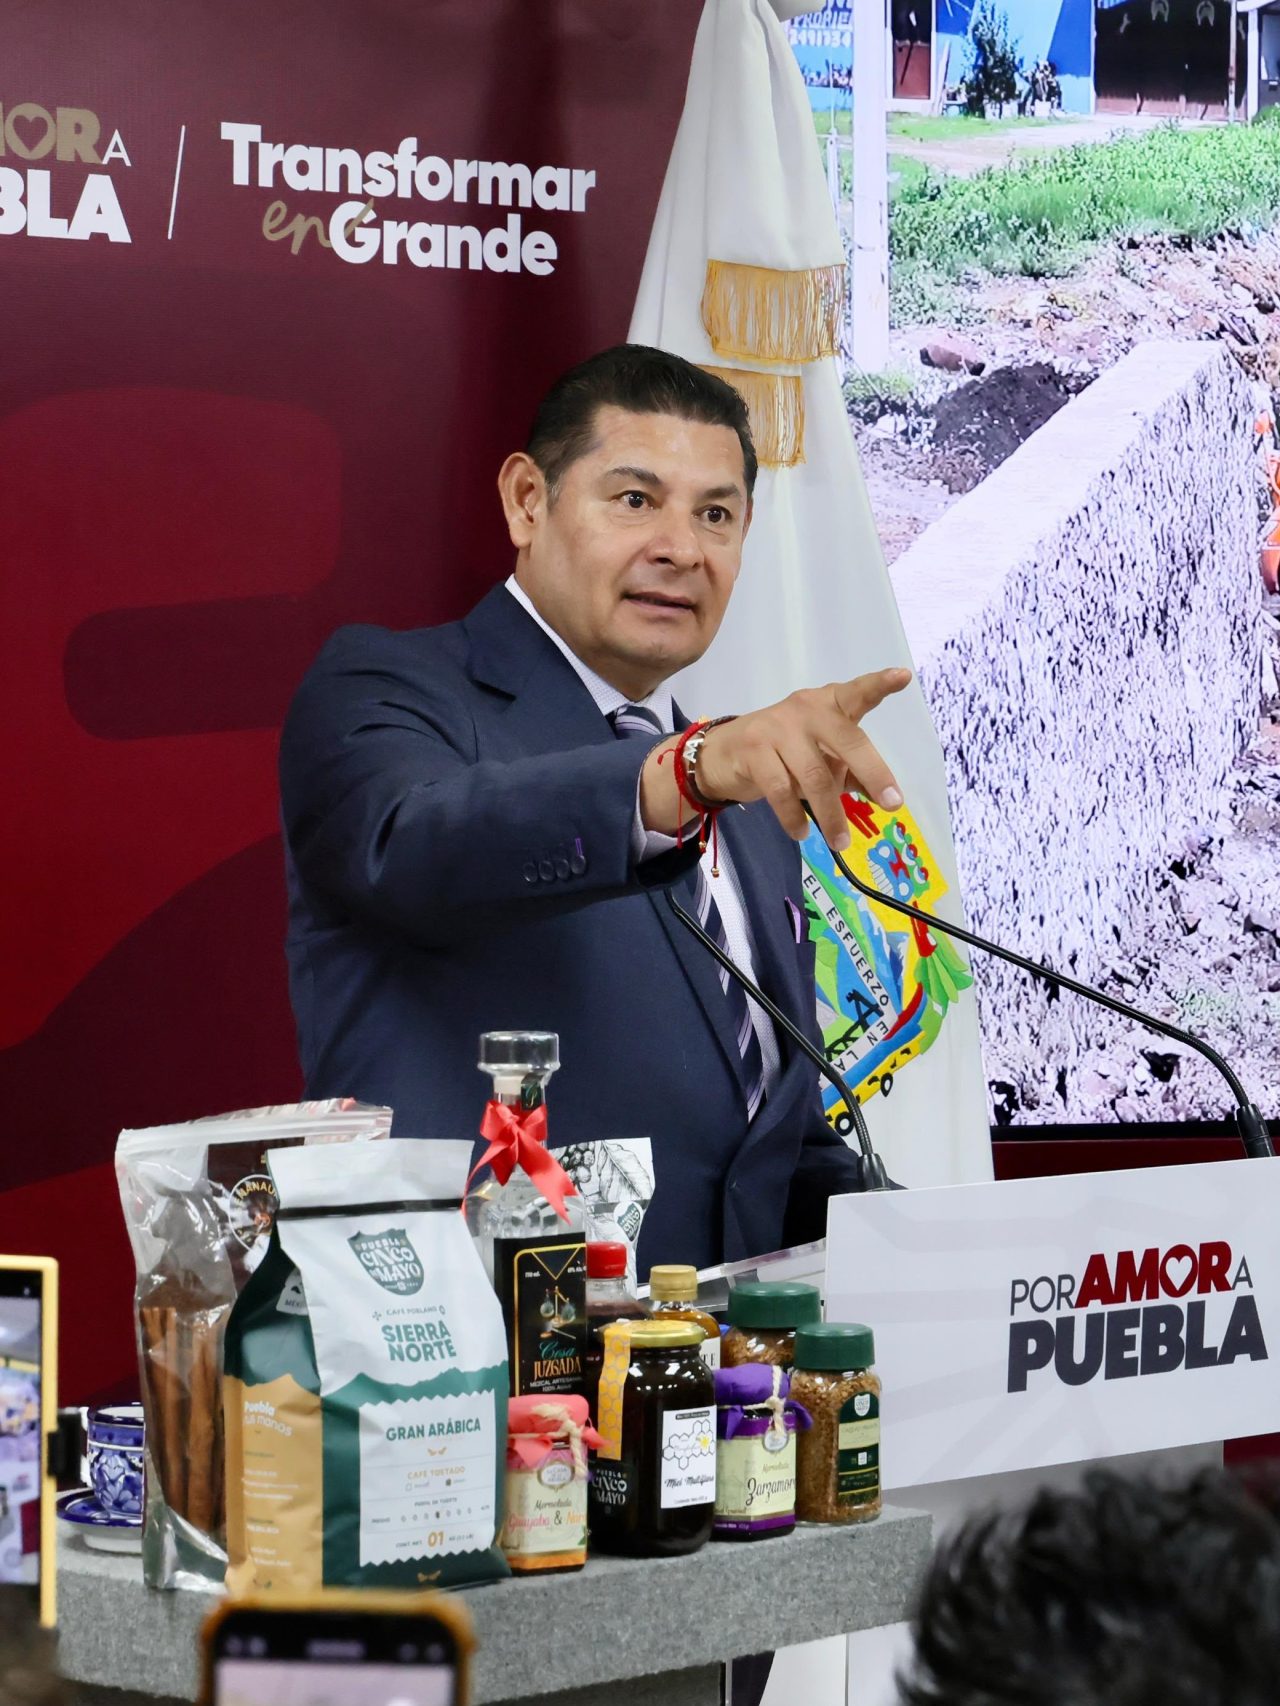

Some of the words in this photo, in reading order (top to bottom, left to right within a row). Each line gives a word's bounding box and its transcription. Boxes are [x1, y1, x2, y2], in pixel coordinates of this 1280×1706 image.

[0, 102, 102, 165] OR
[101, 128, 132, 167] A
[220, 121, 597, 213] Transformar
[262, 199, 334, 255] en
[328, 200, 558, 276] Grande
[803, 874, 822, 900] EL
[825, 906, 890, 1007] ESFUERZO
[867, 1020, 889, 1046] EN
[834, 1048, 859, 1072] LA
[360, 1247, 415, 1267] CINCO
[375, 1262, 421, 1282] MAYO
[1010, 1273, 1076, 1316] POR
[1074, 1240, 1233, 1309] AMOR
[1231, 1254, 1254, 1291] A
[381, 1319, 451, 1343] SIERRA
[388, 1338, 457, 1362] NORTE
[1007, 1294, 1269, 1394] PUEBLA
[533, 1356, 582, 1381] JUZGADA
[386, 1423, 425, 1441] GRAN
[428, 1417, 481, 1436] ARÁBICA
[745, 1477, 797, 1507] Zarzamor
[553, 1510, 562, 1526] &
[428, 1531, 444, 1548] 01
